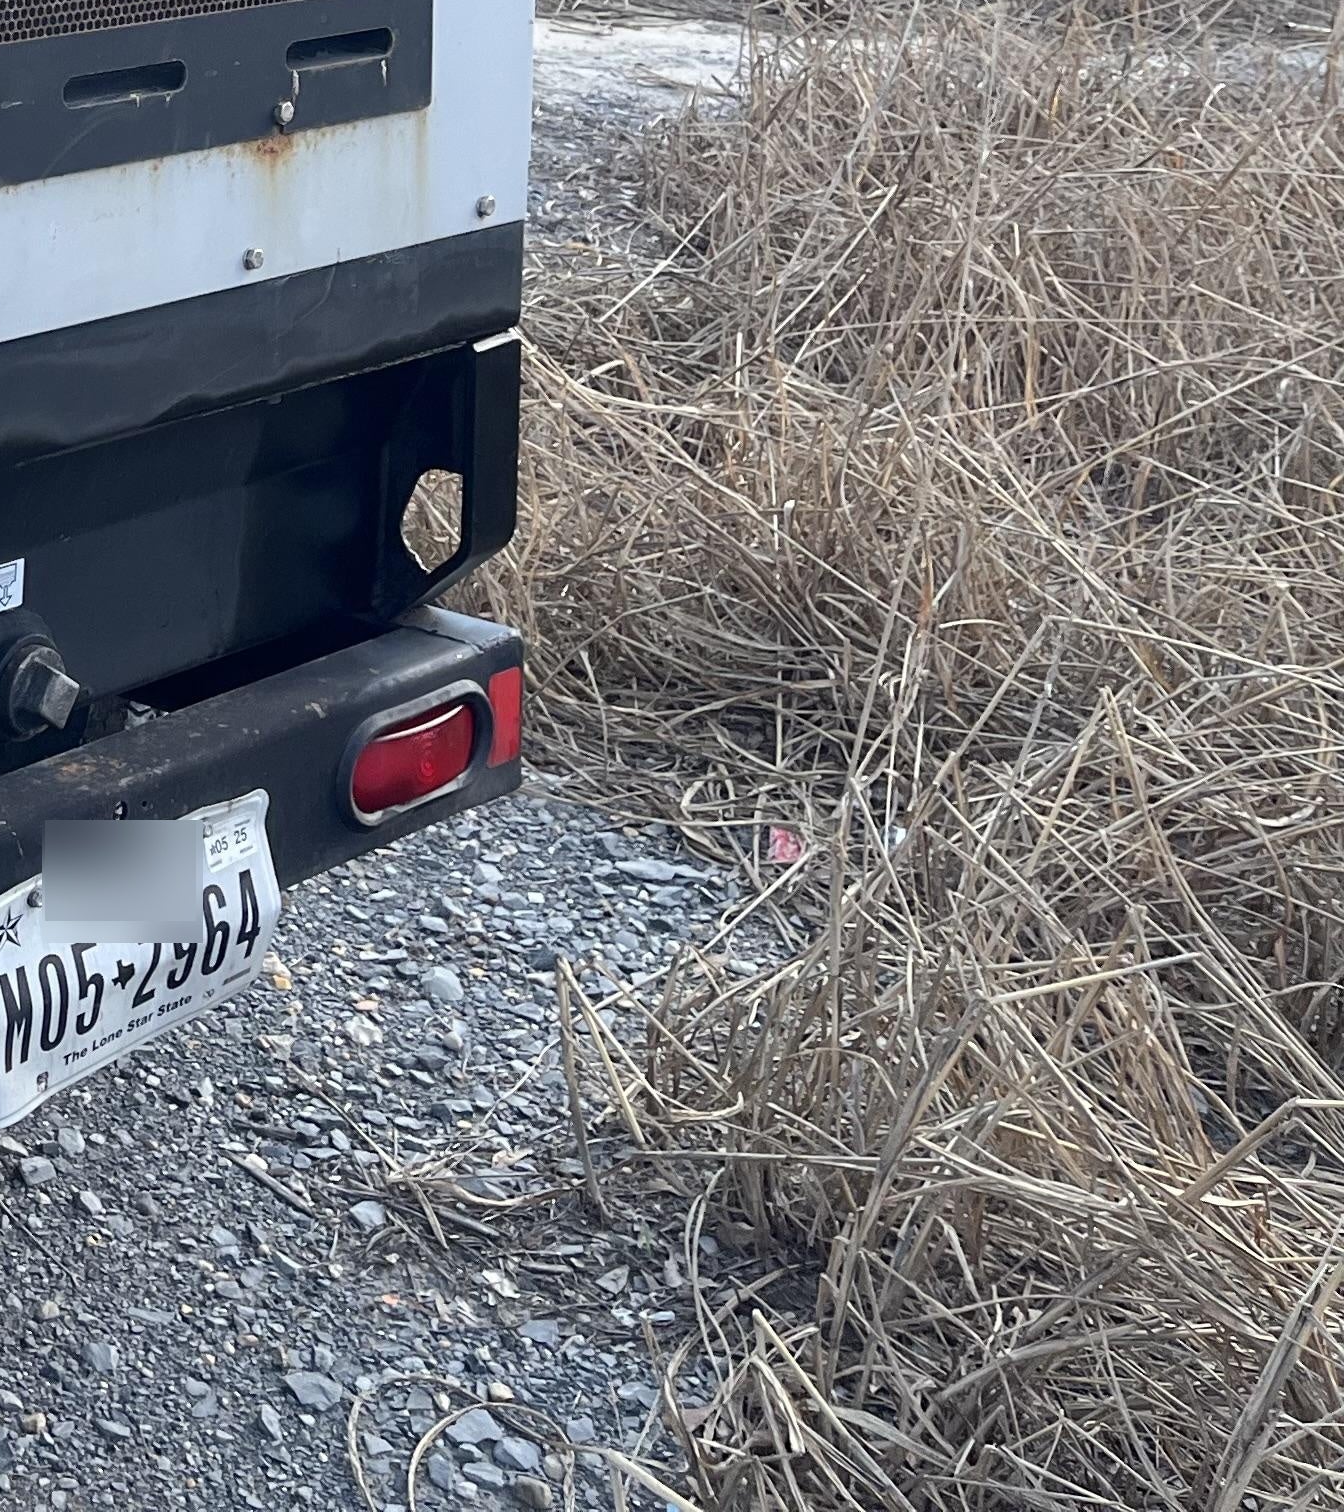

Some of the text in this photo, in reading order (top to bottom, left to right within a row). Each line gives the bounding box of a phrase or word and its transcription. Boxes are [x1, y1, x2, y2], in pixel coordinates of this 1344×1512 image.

[63, 994, 193, 1066] The Lone Star State
